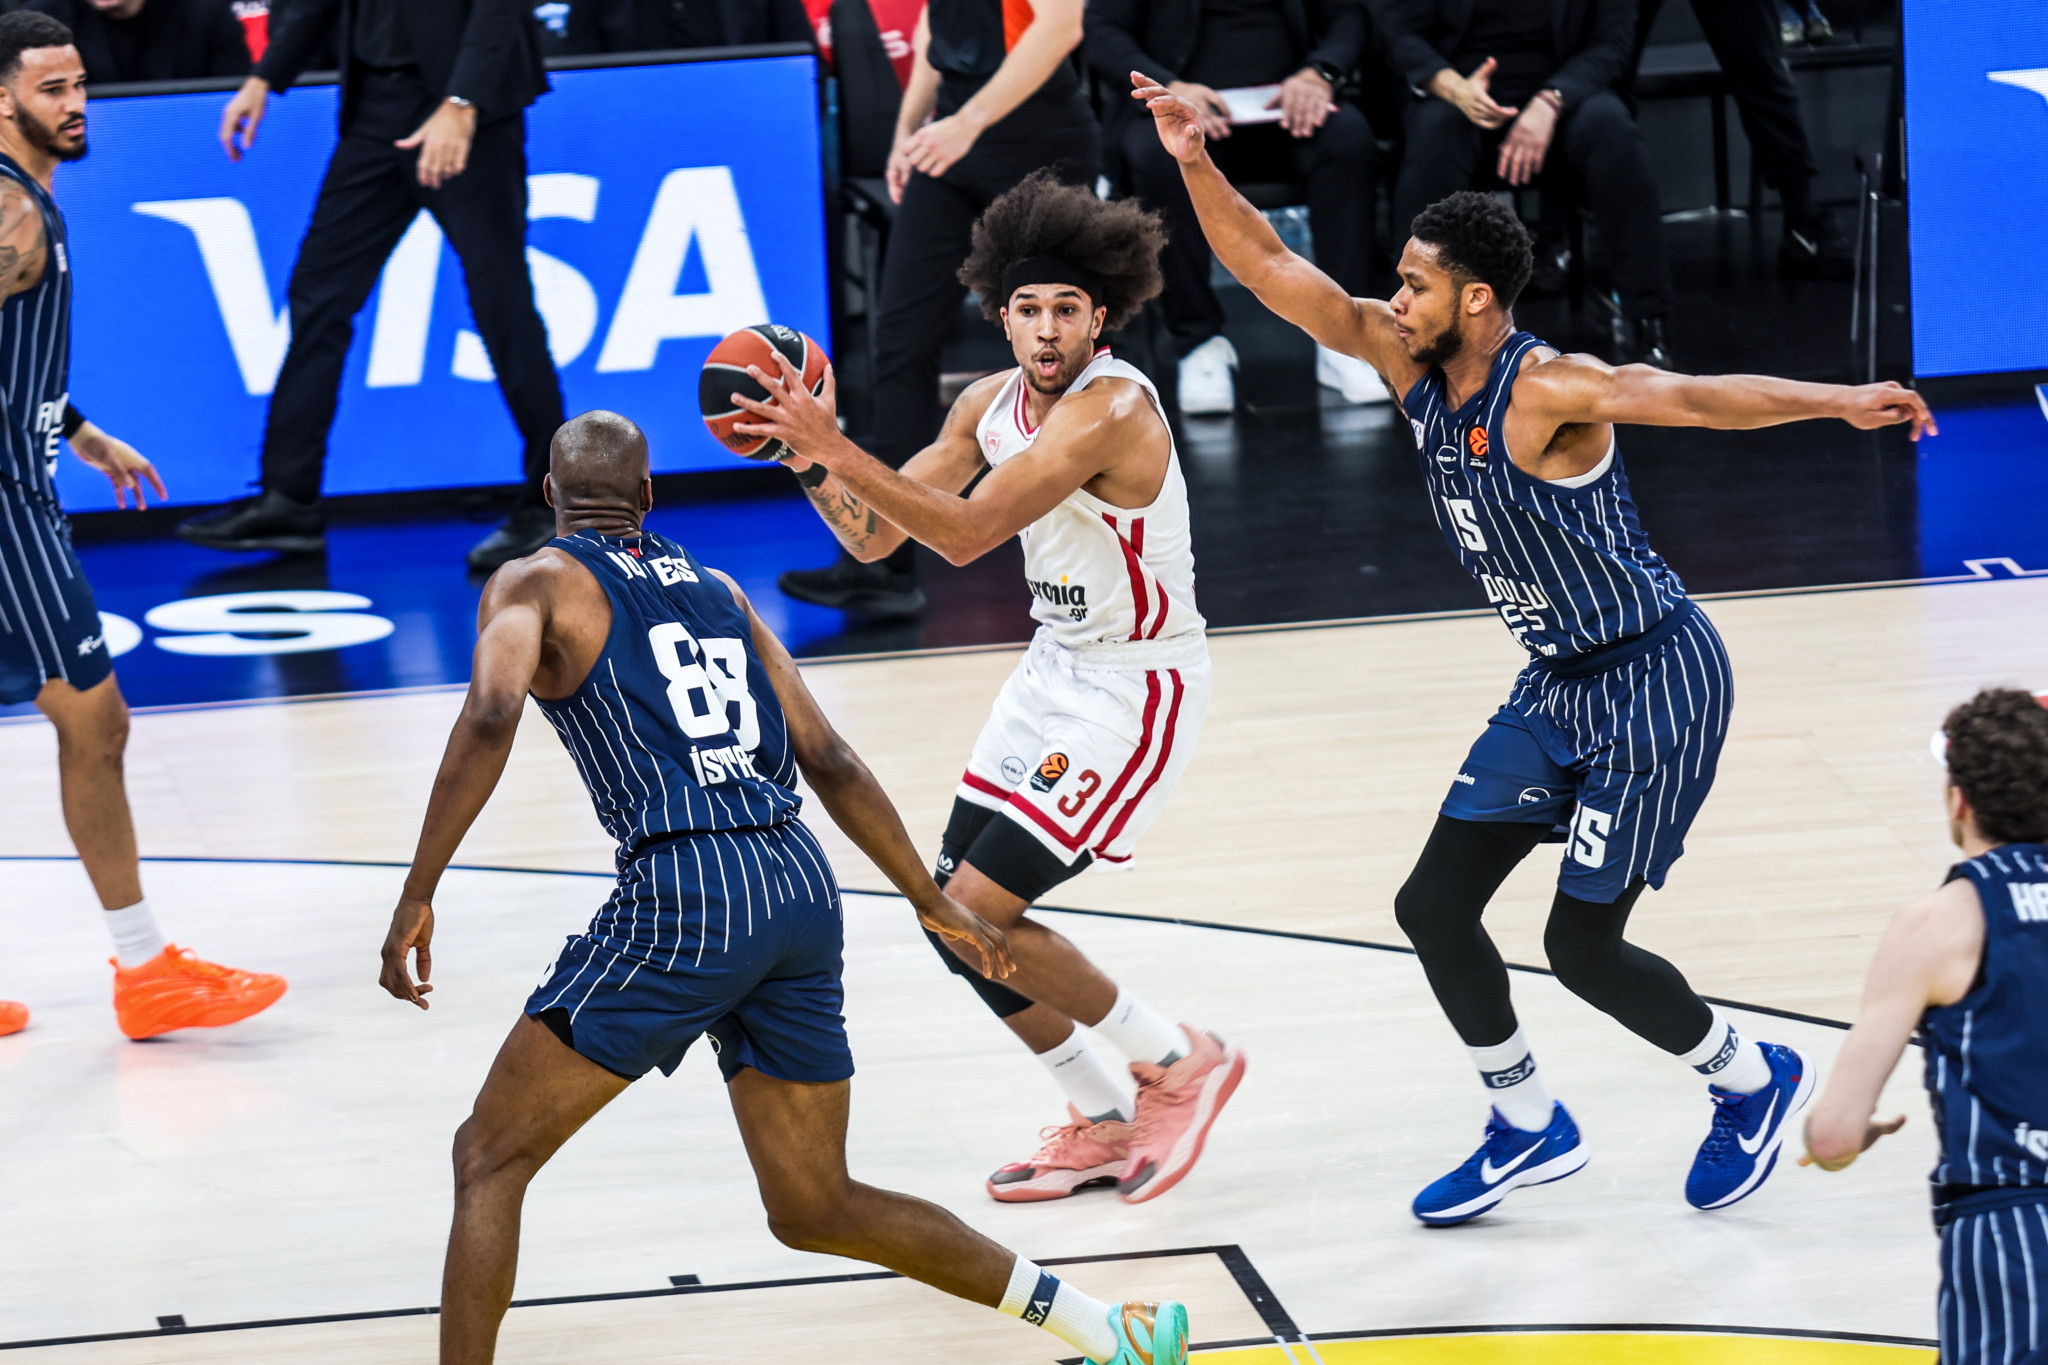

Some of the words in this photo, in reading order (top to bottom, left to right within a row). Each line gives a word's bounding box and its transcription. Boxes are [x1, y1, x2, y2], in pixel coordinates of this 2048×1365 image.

[1068, 607, 1089, 623] .gr
[1057, 768, 1102, 818] 3
[1490, 1059, 1536, 1088] GSA
